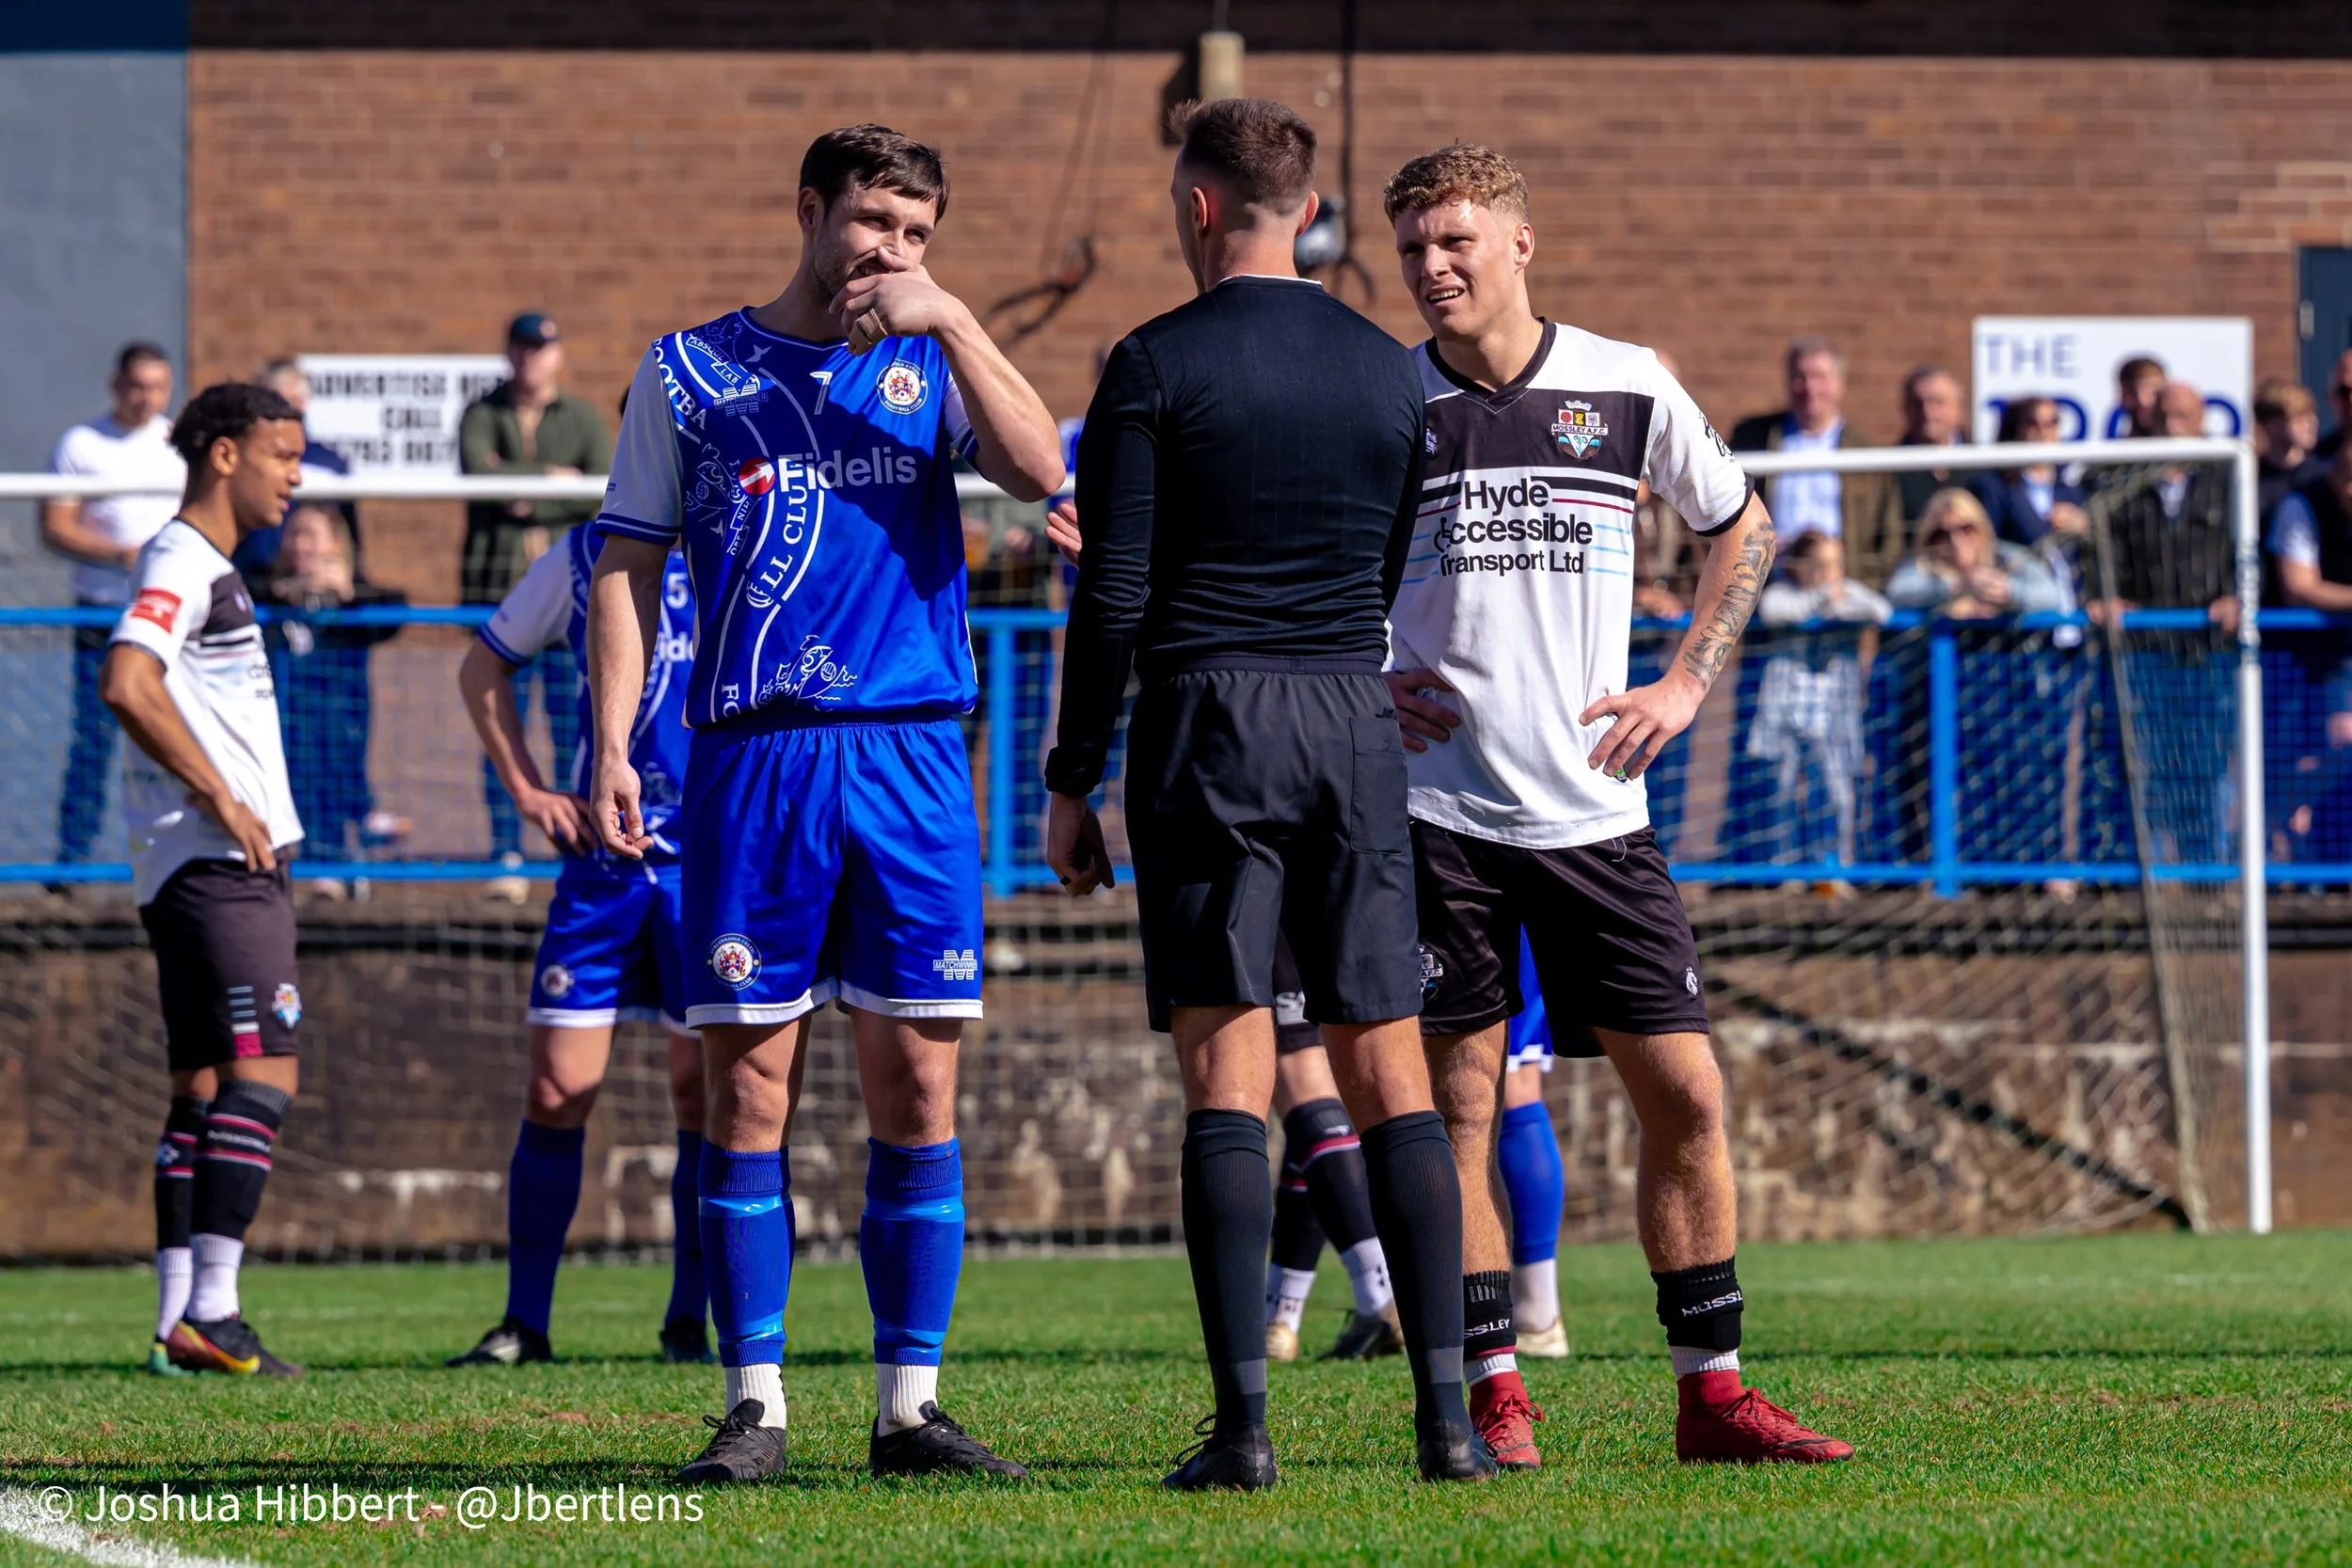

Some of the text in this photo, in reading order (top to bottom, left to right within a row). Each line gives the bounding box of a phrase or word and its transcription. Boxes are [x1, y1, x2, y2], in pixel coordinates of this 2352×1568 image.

[1979, 333, 2075, 377] THE
[720, 368, 739, 384] LAB
[809, 371, 834, 415] 7
[381, 406, 442, 429] CALL
[778, 447, 917, 492] Fidelis
[782, 483, 809, 545] CLU
[1464, 478, 1549, 515] Hyde
[1440, 549, 1584, 577] Transport Ltd
[666, 572, 689, 609] 5
